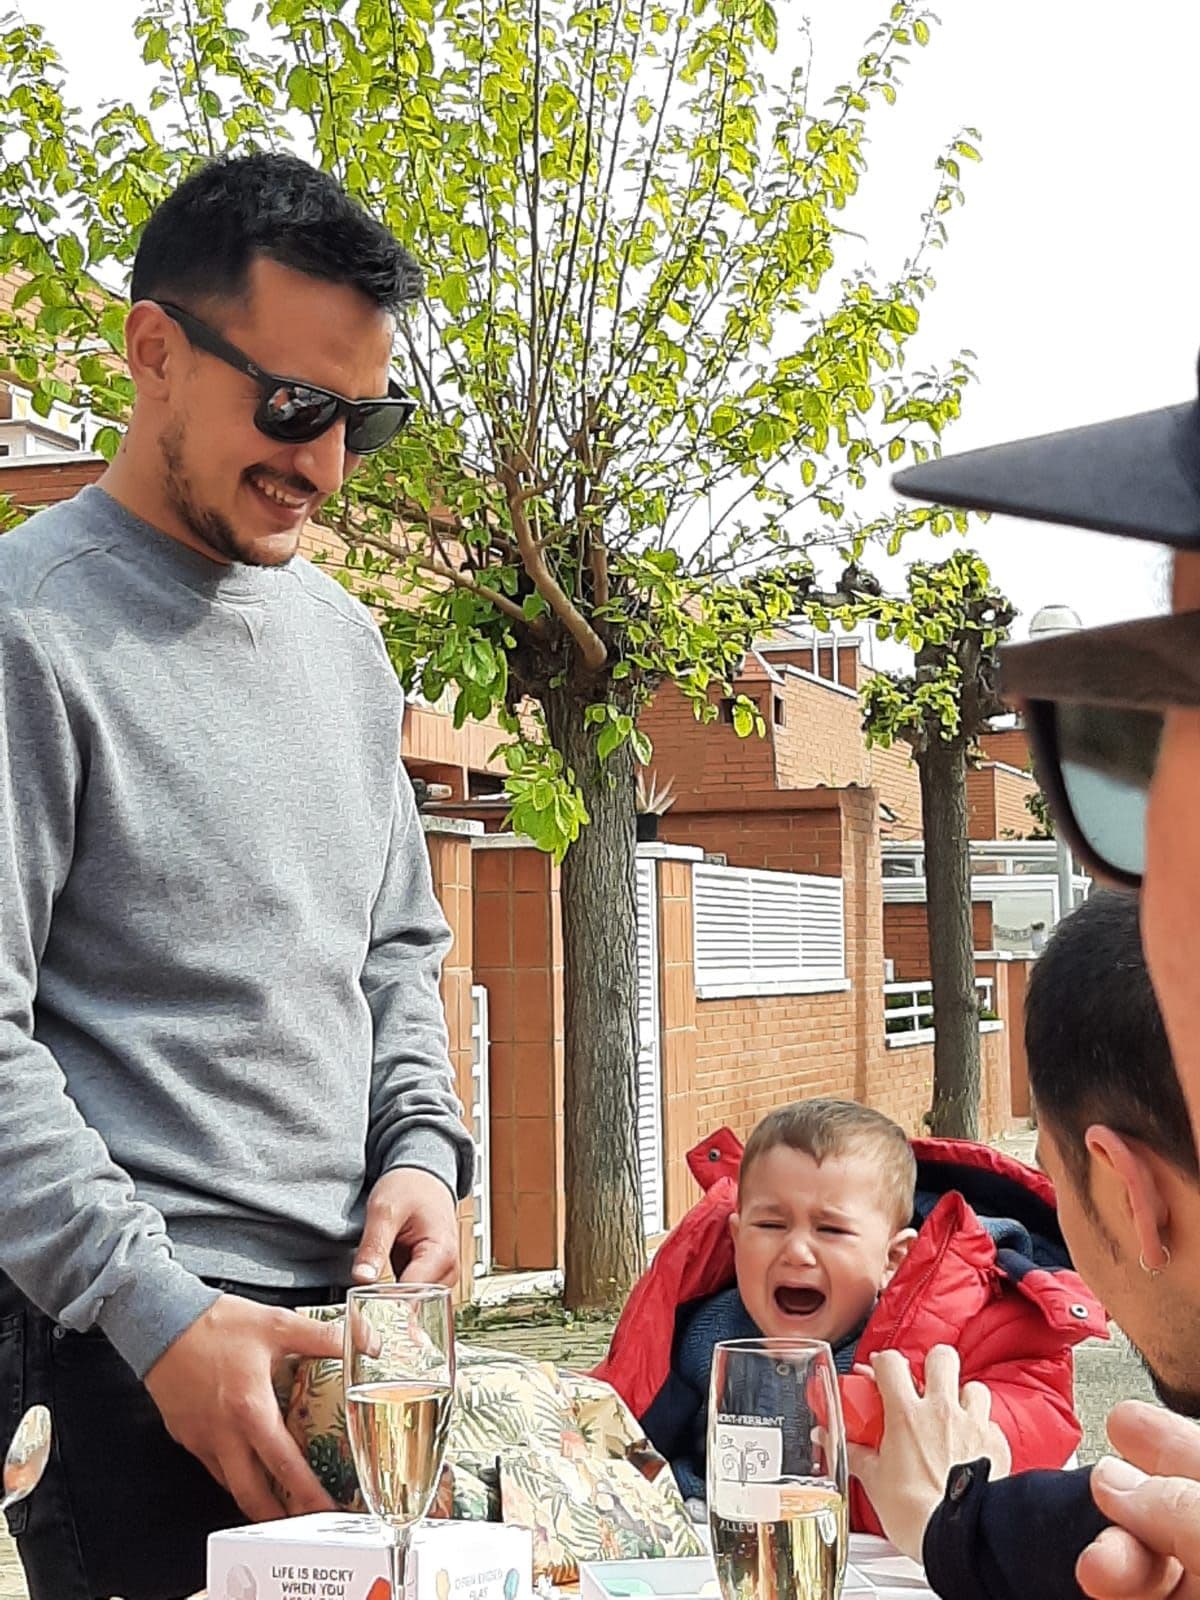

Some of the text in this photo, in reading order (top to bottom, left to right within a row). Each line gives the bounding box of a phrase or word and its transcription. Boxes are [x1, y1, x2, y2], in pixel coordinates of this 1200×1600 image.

[298, 1567, 309, 1580] IS
[312, 1568, 354, 1582] ROCKY
[281, 1582, 345, 1596] WHEN YOU
